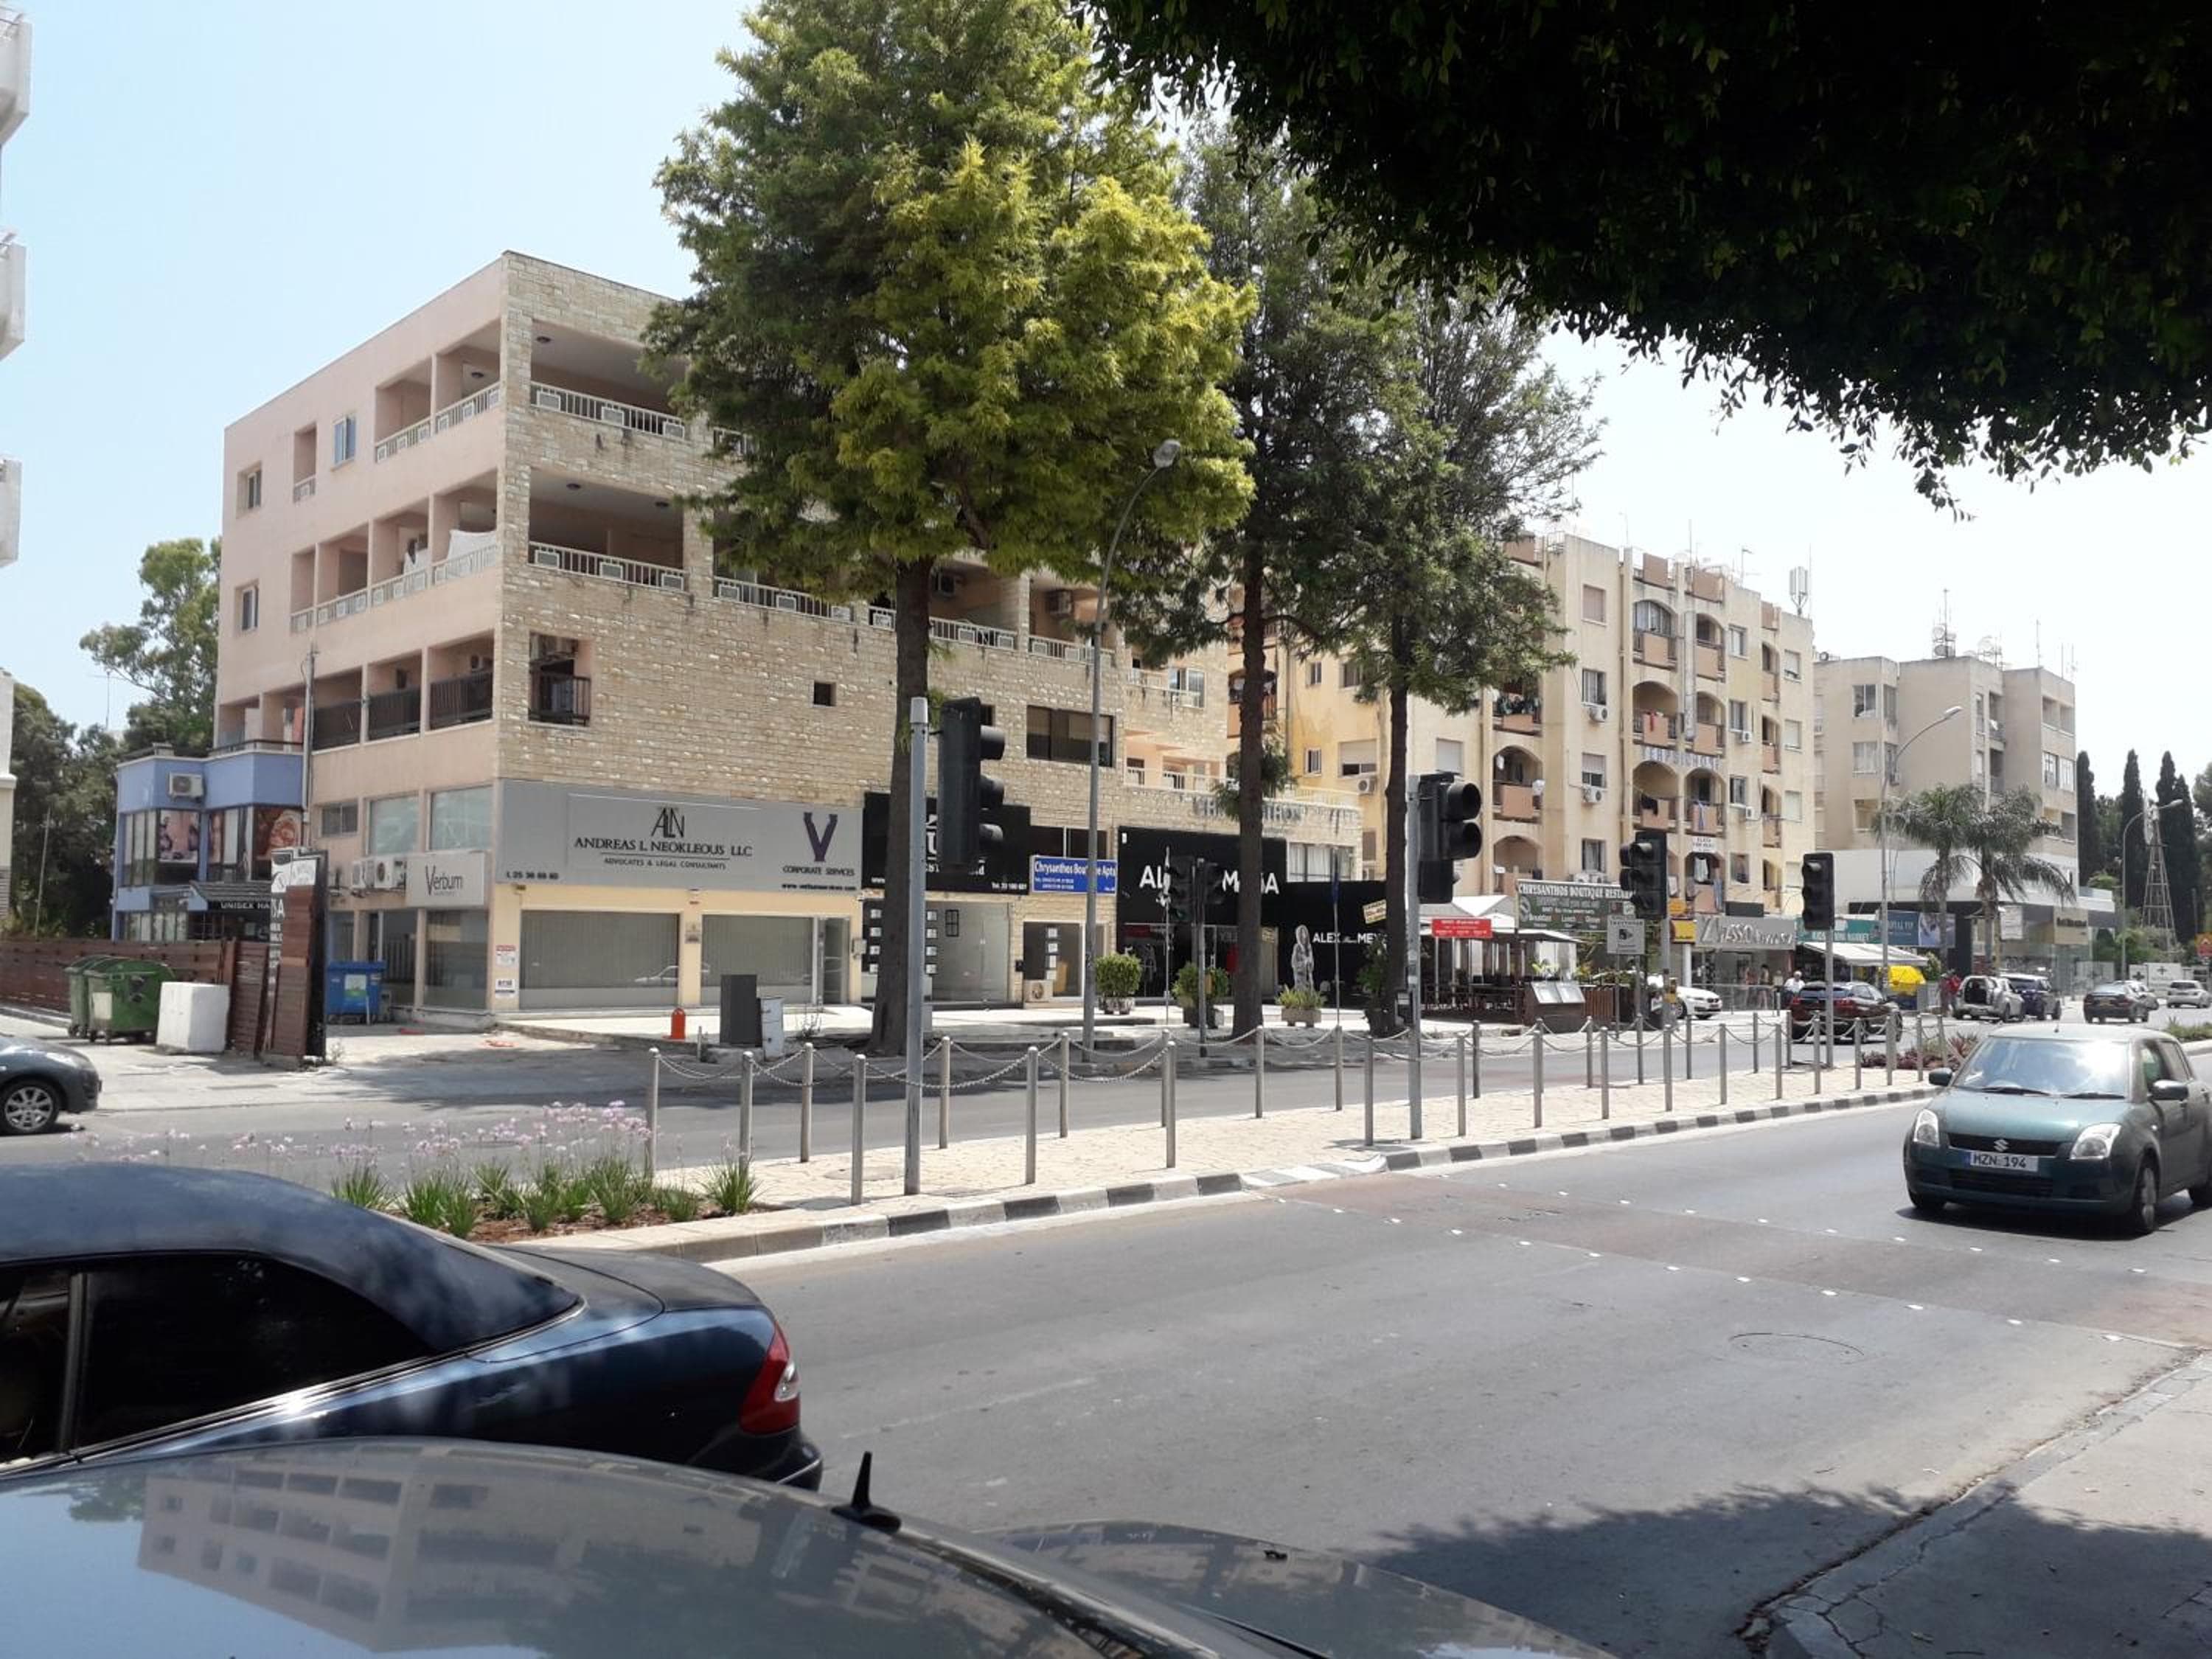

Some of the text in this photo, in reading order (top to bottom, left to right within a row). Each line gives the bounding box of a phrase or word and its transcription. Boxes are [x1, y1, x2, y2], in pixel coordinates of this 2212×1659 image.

[803, 812, 838, 862] V
[574, 837, 636, 850] ANDREAS
[650, 841, 725, 855] NEOKLEOUS
[731, 846, 753, 857] LLC
[605, 857, 644, 866] ADVOCATES
[681, 860, 727, 870] CONSULTANTS
[1034, 860, 1073, 875] Chrysanthos
[782, 865, 856, 877] CORPORATE SERVICES
[425, 864, 464, 896] Verbum
[1569, 887, 1604, 900] BOUTIQUE
[220, 901, 254, 909] UNISEX
[1312, 932, 1340, 943] ALEX
